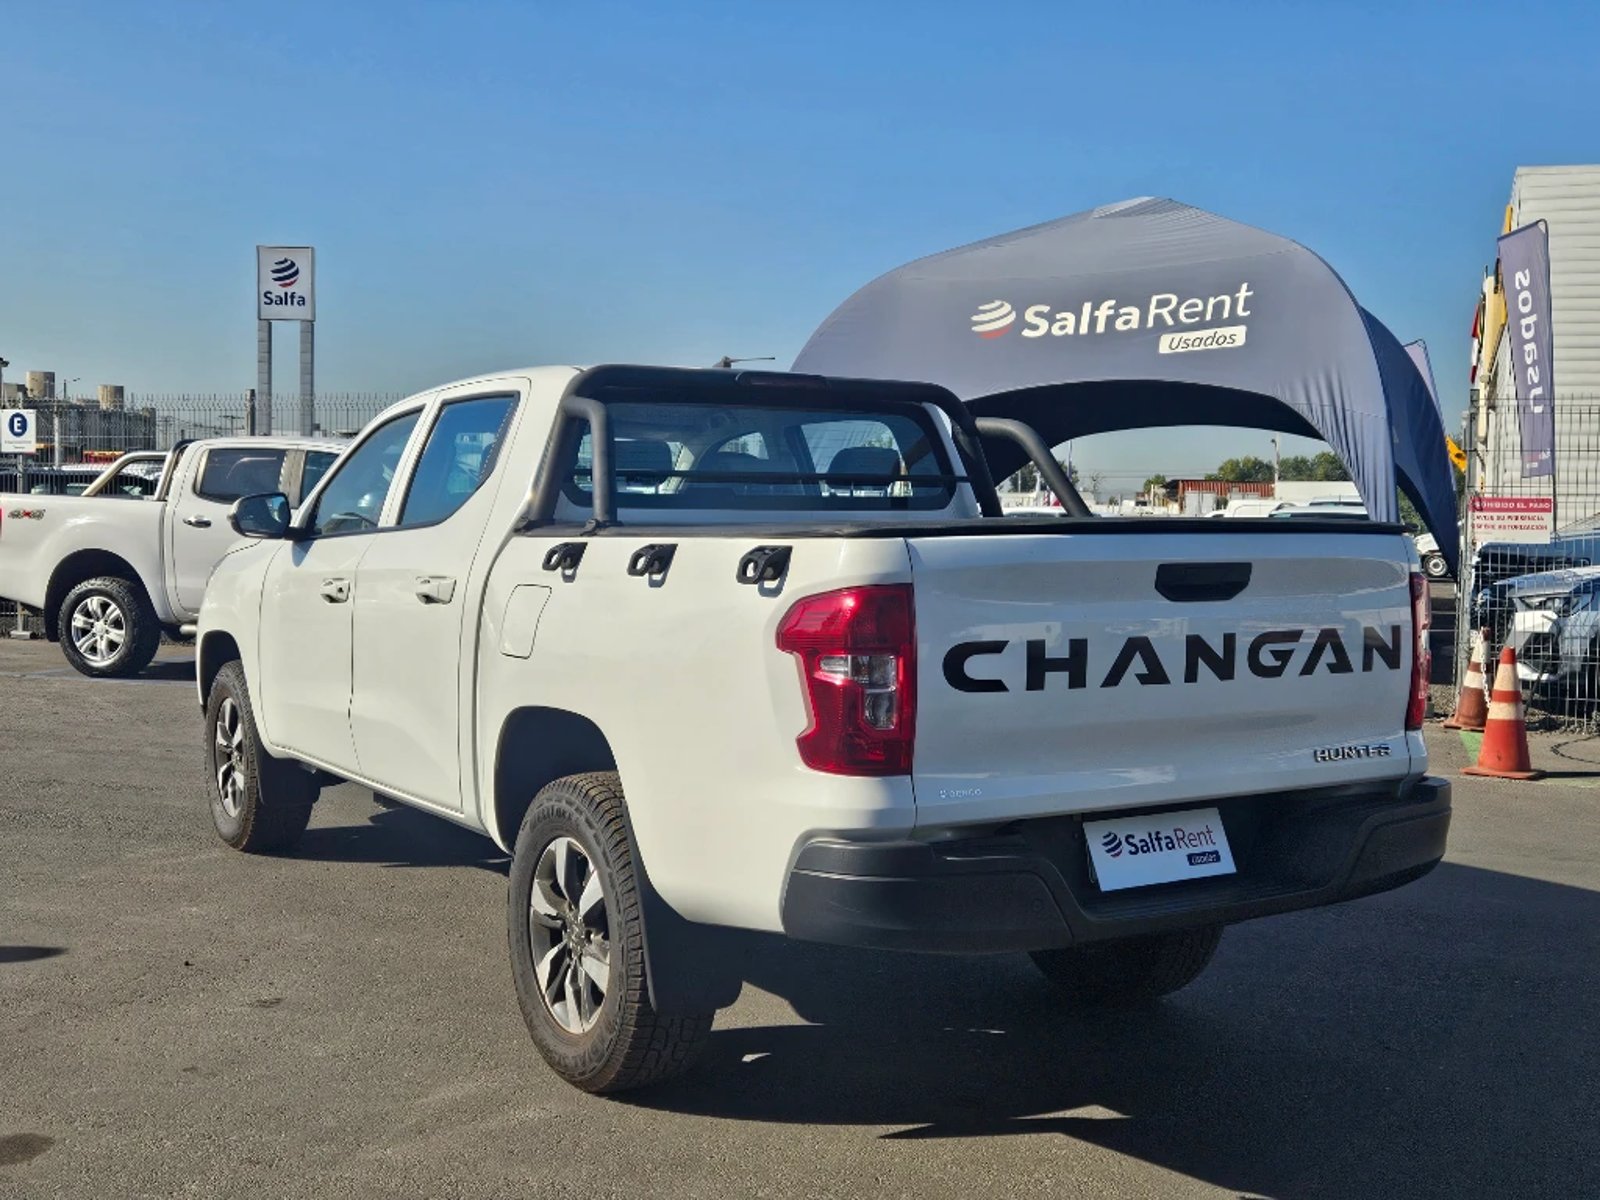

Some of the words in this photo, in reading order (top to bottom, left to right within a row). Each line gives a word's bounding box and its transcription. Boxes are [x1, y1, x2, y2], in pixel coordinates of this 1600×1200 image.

[263, 290, 306, 306] Salfa
[1168, 331, 1237, 351] Usados
[13, 416, 23, 432] E
[1469, 501, 1515, 509] OHIBIDO
[942, 624, 1401, 693] CHANGAN
[1313, 743, 1392, 763] HUNTER
